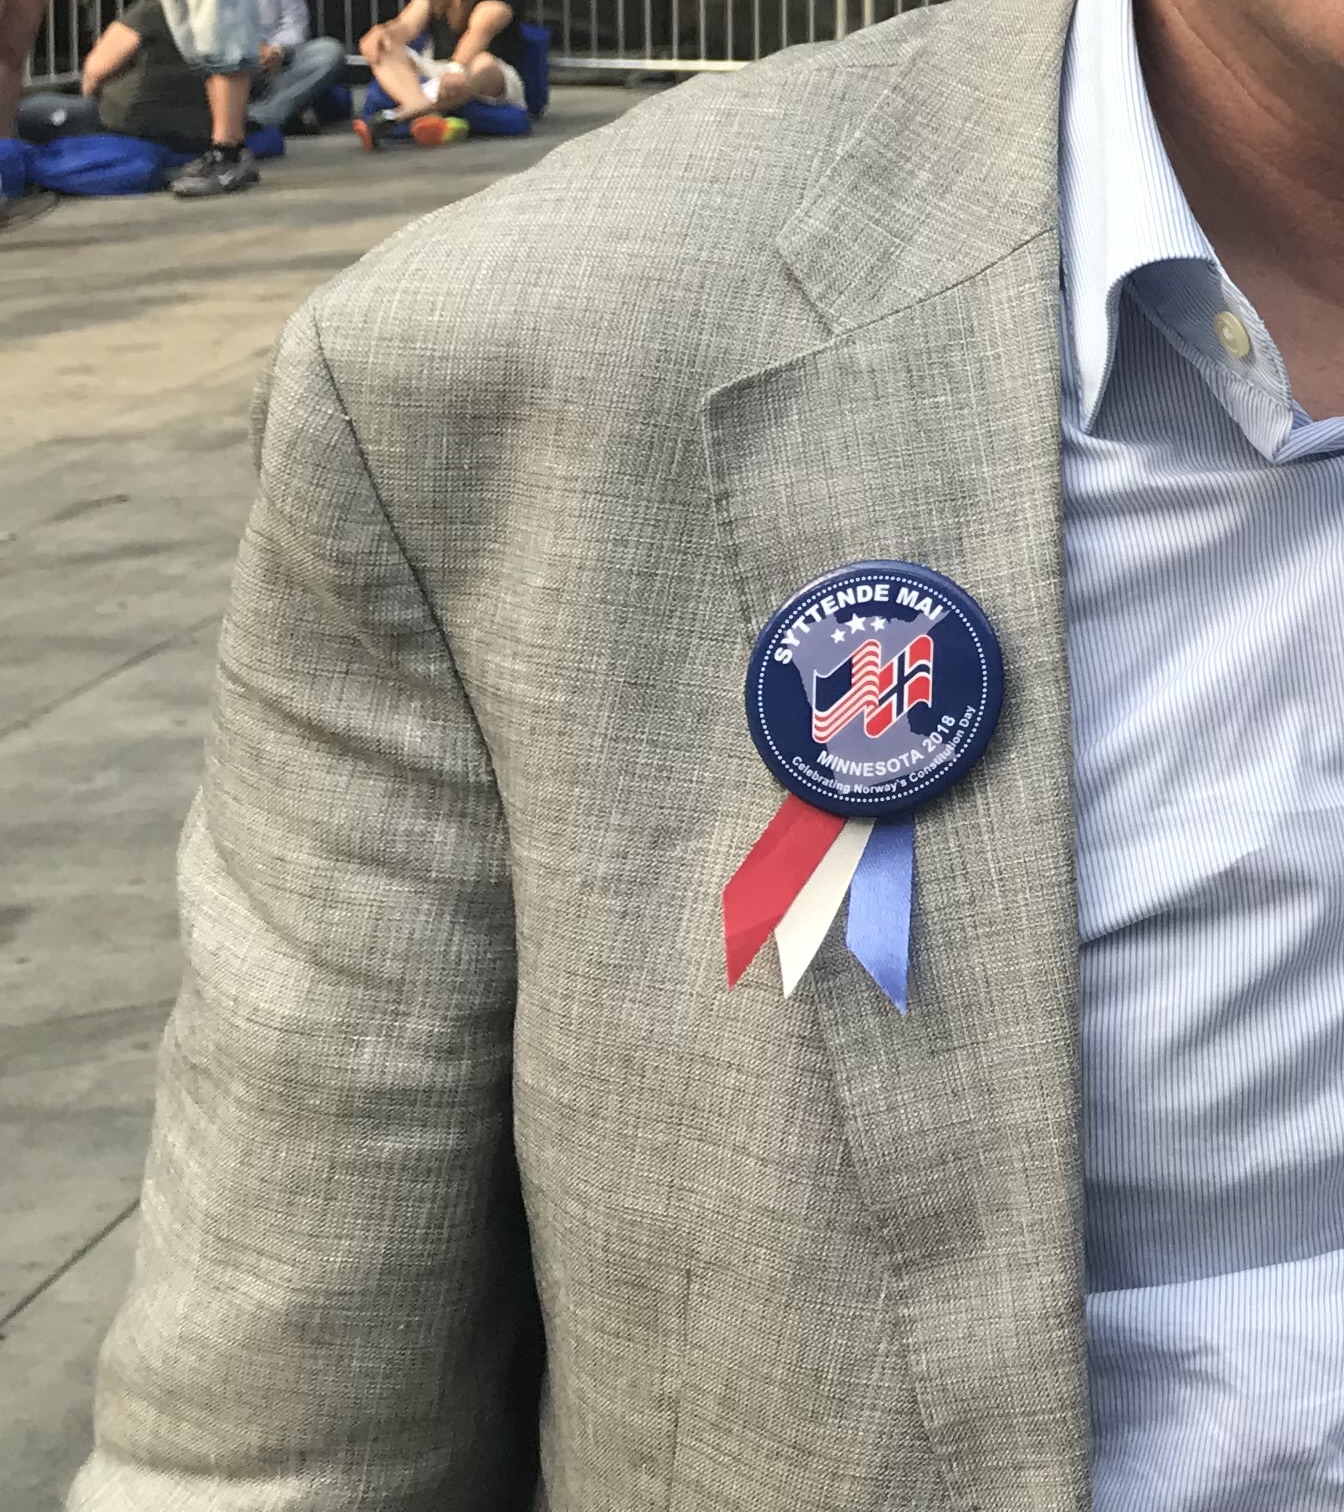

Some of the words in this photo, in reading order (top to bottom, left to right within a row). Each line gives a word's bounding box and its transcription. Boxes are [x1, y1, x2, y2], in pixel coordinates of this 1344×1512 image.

[774, 584, 890, 665] SYTTENDE
[896, 586, 943, 620] MAI
[792, 755, 851, 794] Celebrating
[853, 778, 908, 794] Norway's
[908, 734, 961, 783] Constitution
[958, 704, 977, 729] Day
[816, 749, 924, 777] MINNESOTA
[921, 714, 956, 754] 2018
